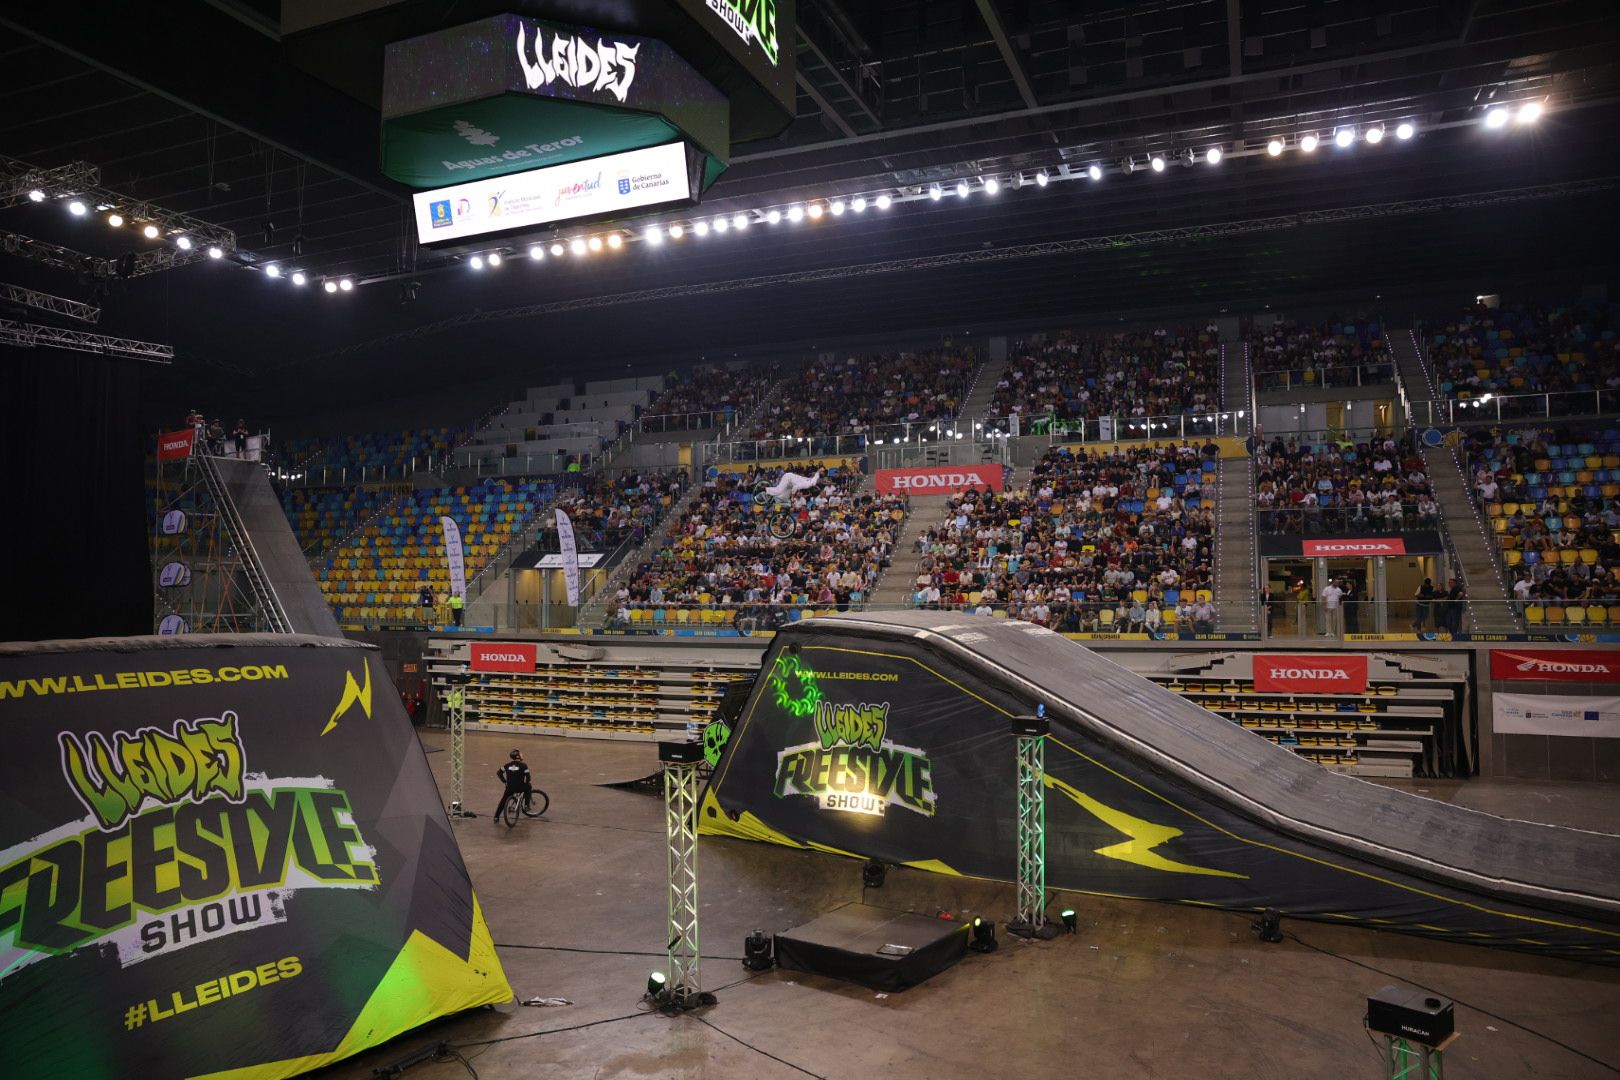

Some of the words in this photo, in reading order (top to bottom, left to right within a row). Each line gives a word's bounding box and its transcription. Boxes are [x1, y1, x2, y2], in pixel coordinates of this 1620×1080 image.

[516, 20, 641, 103] LLEIDES
[441, 154, 503, 171] Aguas
[502, 145, 533, 161] de
[525, 134, 585, 156] Teror
[631, 172, 662, 184] Gobierno
[632, 183, 641, 191] de
[641, 179, 670, 190] Canarias
[163, 439, 190, 451] HONDA
[892, 471, 985, 490] HONDA
[1313, 543, 1393, 552] HONDA
[480, 652, 527, 663] HONDA
[795, 670, 898, 682] WWW.LLEIDES.COM
[1269, 668, 1350, 680] HONDA
[1536, 663, 1611, 674] HONDA
[815, 701, 889, 752] LLEIDES
[61, 713, 244, 828] LLEIDES
[775, 748, 936, 815] FREESTYLE
[826, 794, 875, 811] SHOW
[140, 894, 262, 953] SHOW
[124, 956, 303, 1031] #LLEIDES
